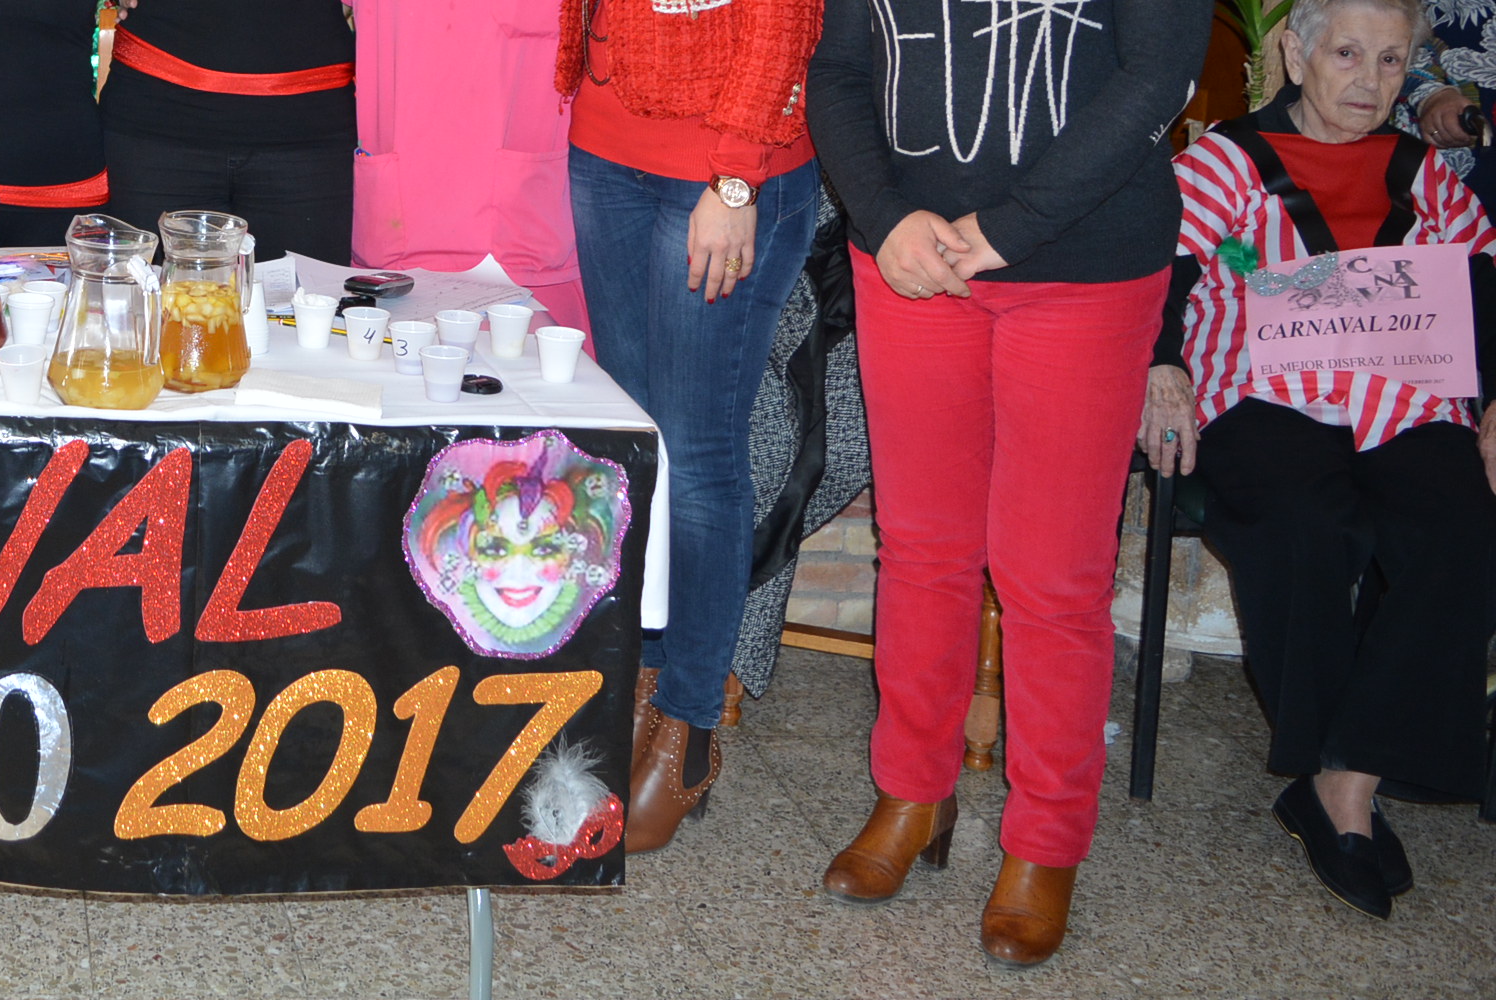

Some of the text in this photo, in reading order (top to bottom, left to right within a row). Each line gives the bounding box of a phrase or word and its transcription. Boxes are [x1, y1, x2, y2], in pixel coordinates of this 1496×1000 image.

[363, 327, 376, 344] 4
[1258, 313, 1437, 341] CARNAVAL 2017
[396, 339, 409, 356] 3
[1261, 354, 1454, 375] EL MEJOR DISFRAZ LLEVADO
[114, 665, 603, 843] 2017
